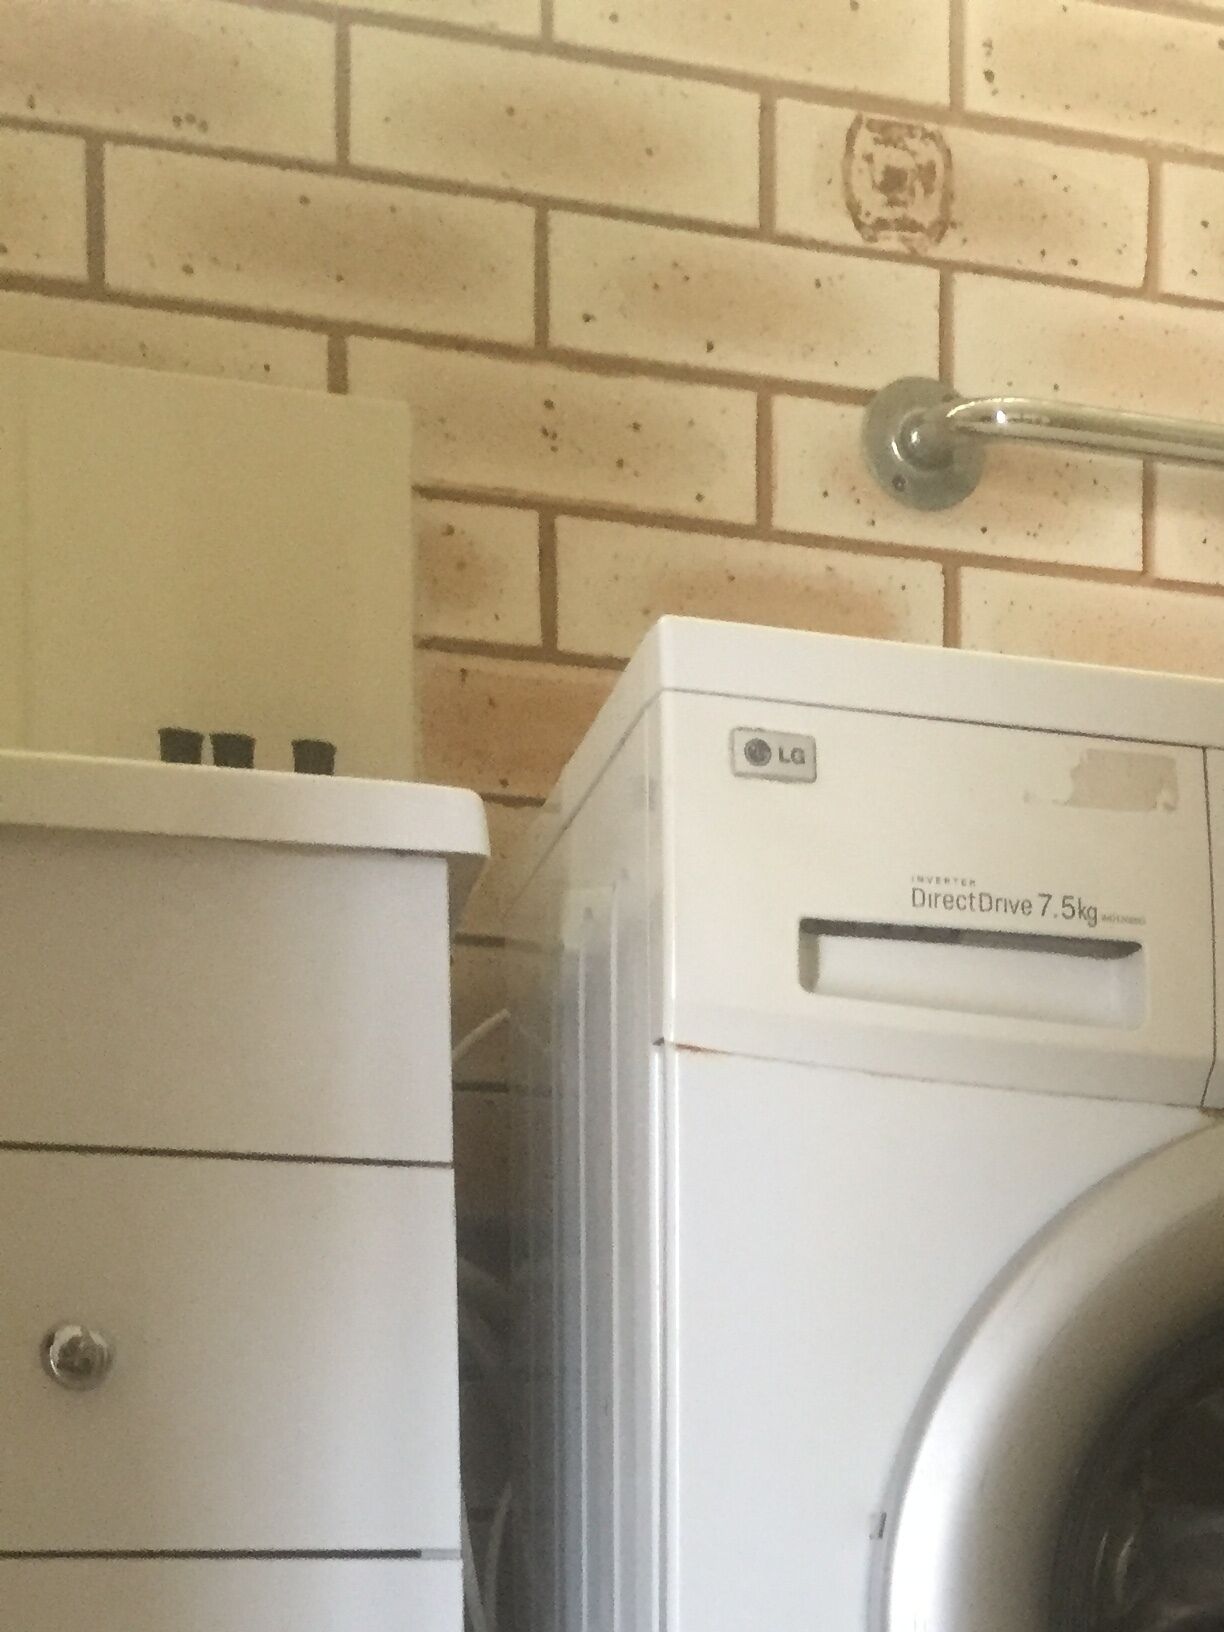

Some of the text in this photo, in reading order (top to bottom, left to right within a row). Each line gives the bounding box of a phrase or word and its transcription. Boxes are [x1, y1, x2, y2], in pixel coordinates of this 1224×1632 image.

[779, 745, 805, 765] LG
[911, 874, 976, 887] INVERTER
[1038, 892, 1098, 928] 7.5kg
